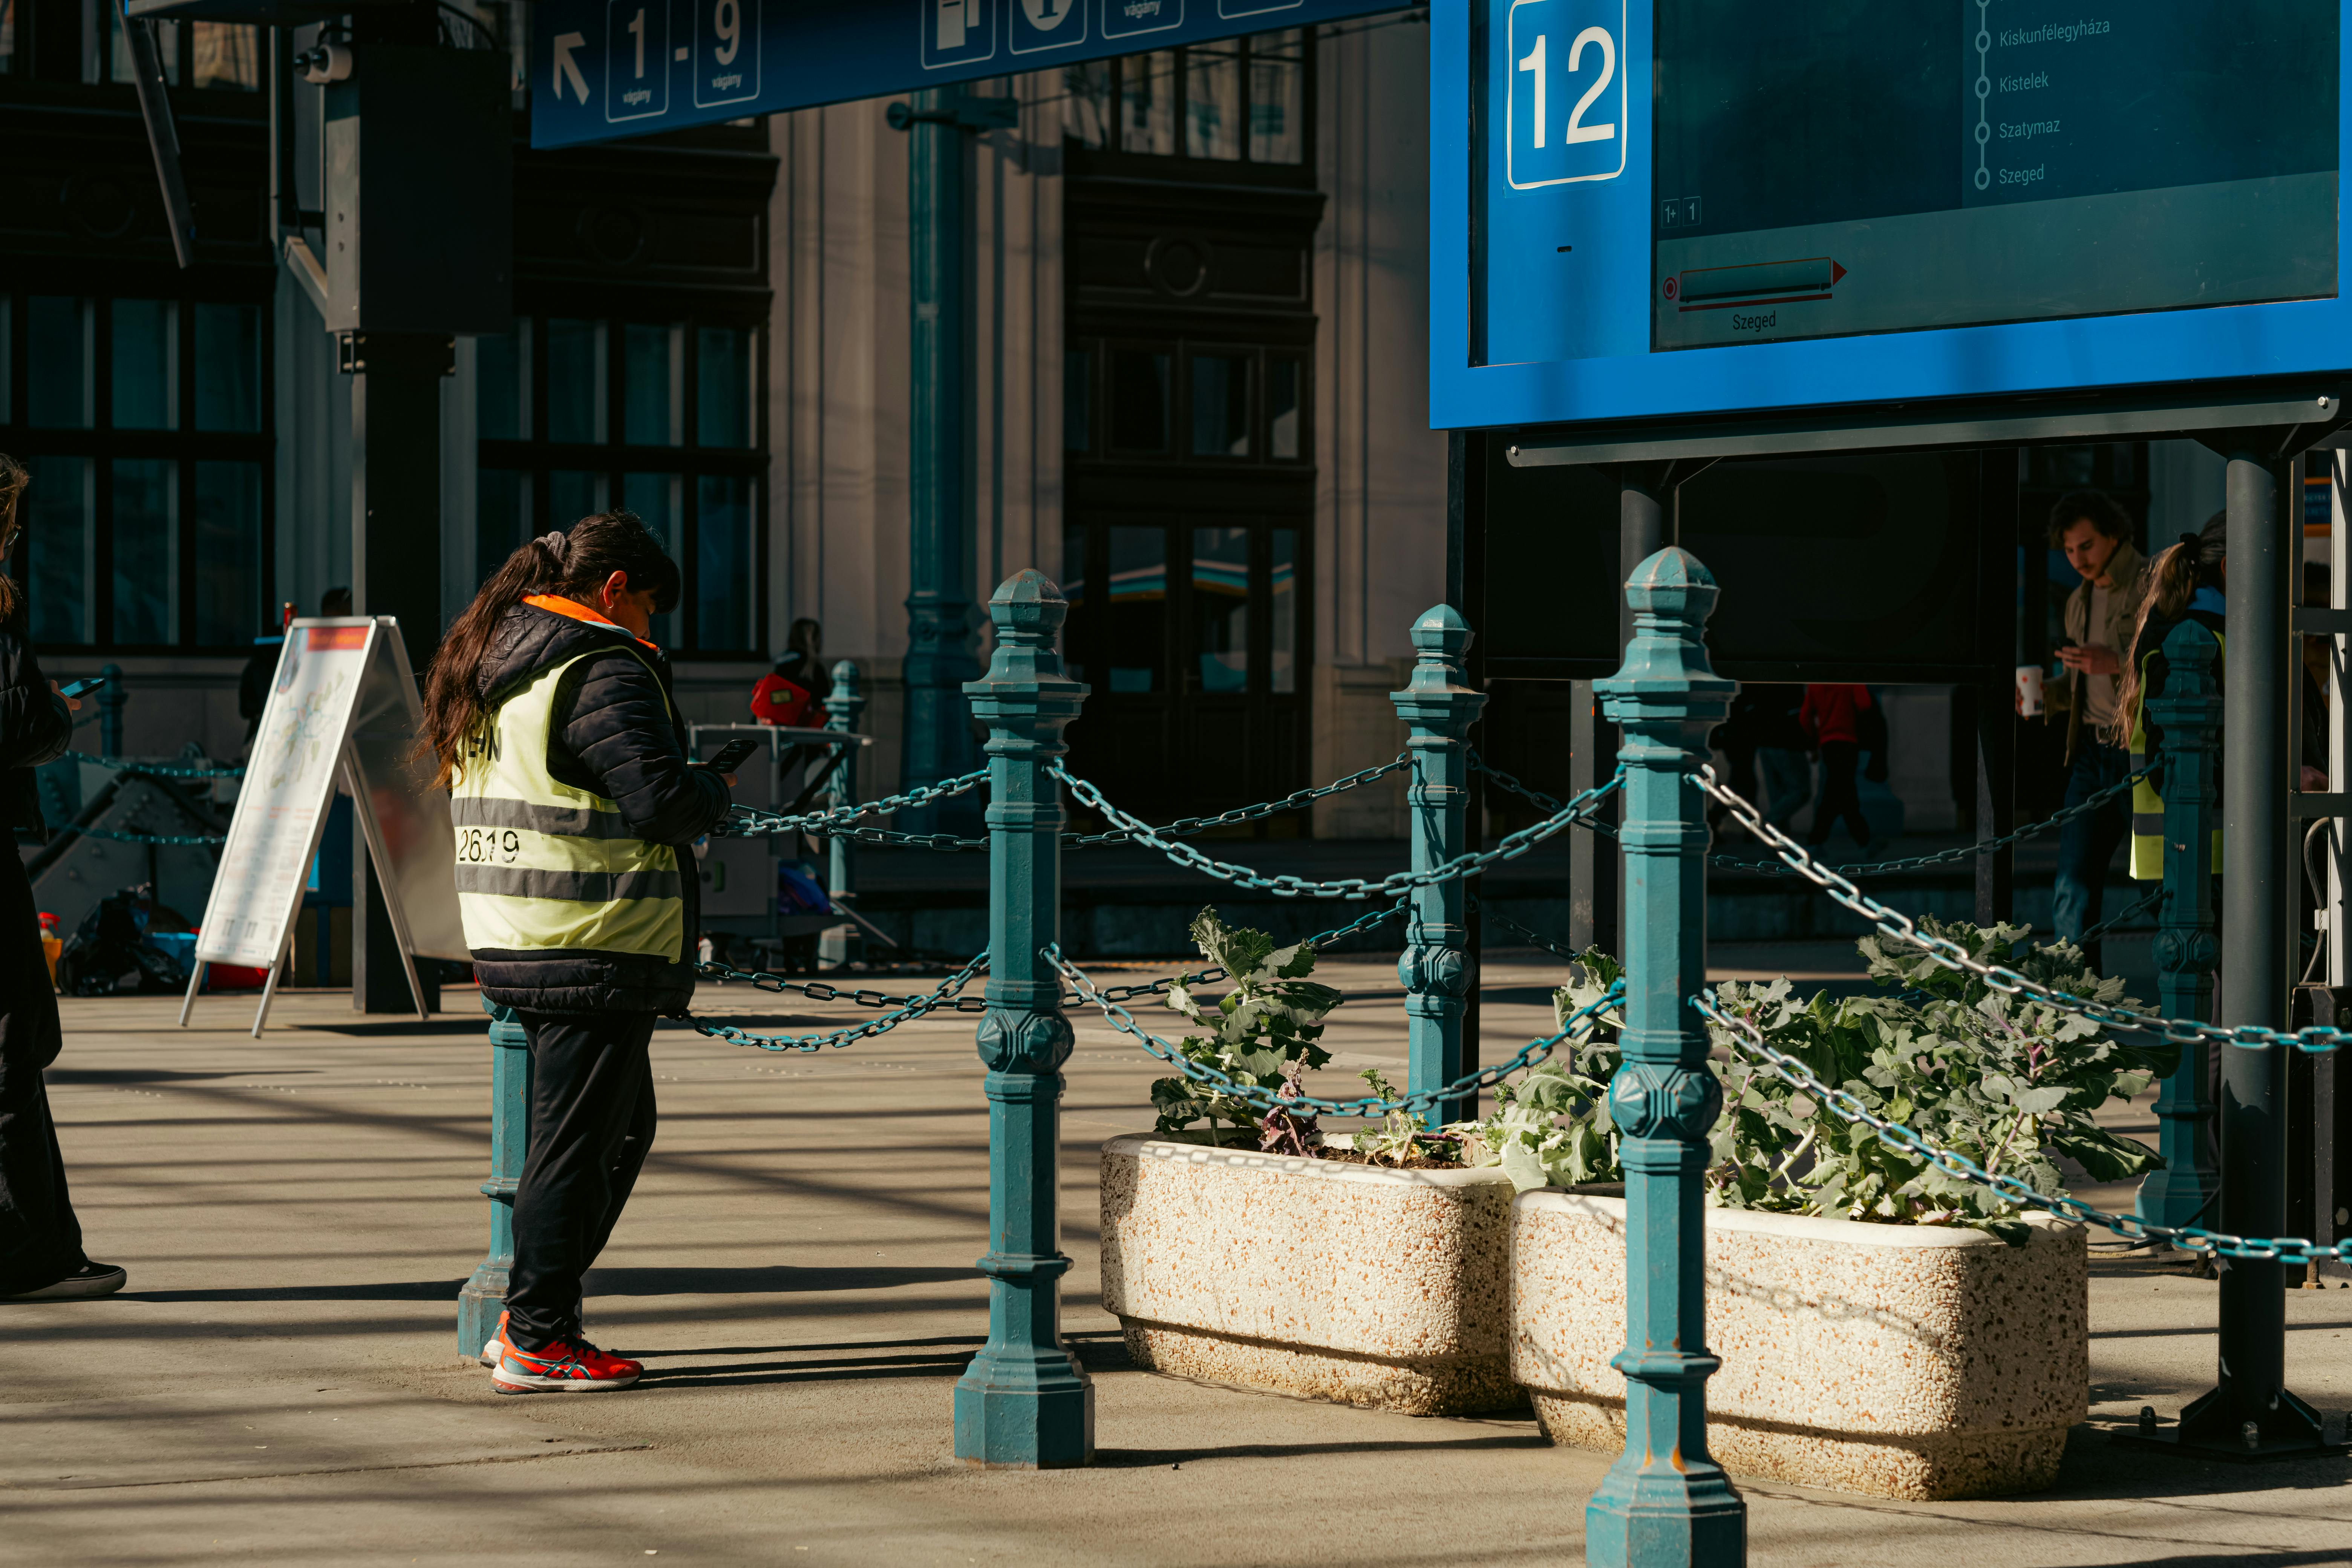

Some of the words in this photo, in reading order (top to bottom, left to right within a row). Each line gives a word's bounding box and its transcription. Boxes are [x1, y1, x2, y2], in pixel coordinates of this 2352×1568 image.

[628, 8, 645, 79] 1
[715, 0, 740, 66] 9
[2000, 18, 2110, 47] Kiskunfélegyháza
[1519, 26, 1615, 149] 12
[2000, 71, 2049, 93] Kistelek
[1999, 120, 2060, 139] Szatymaz
[1999, 163, 2044, 186] Szeged
[1689, 202, 1695, 220] 1
[1733, 310, 1776, 332] Szeged
[459, 829, 520, 864] 2619
